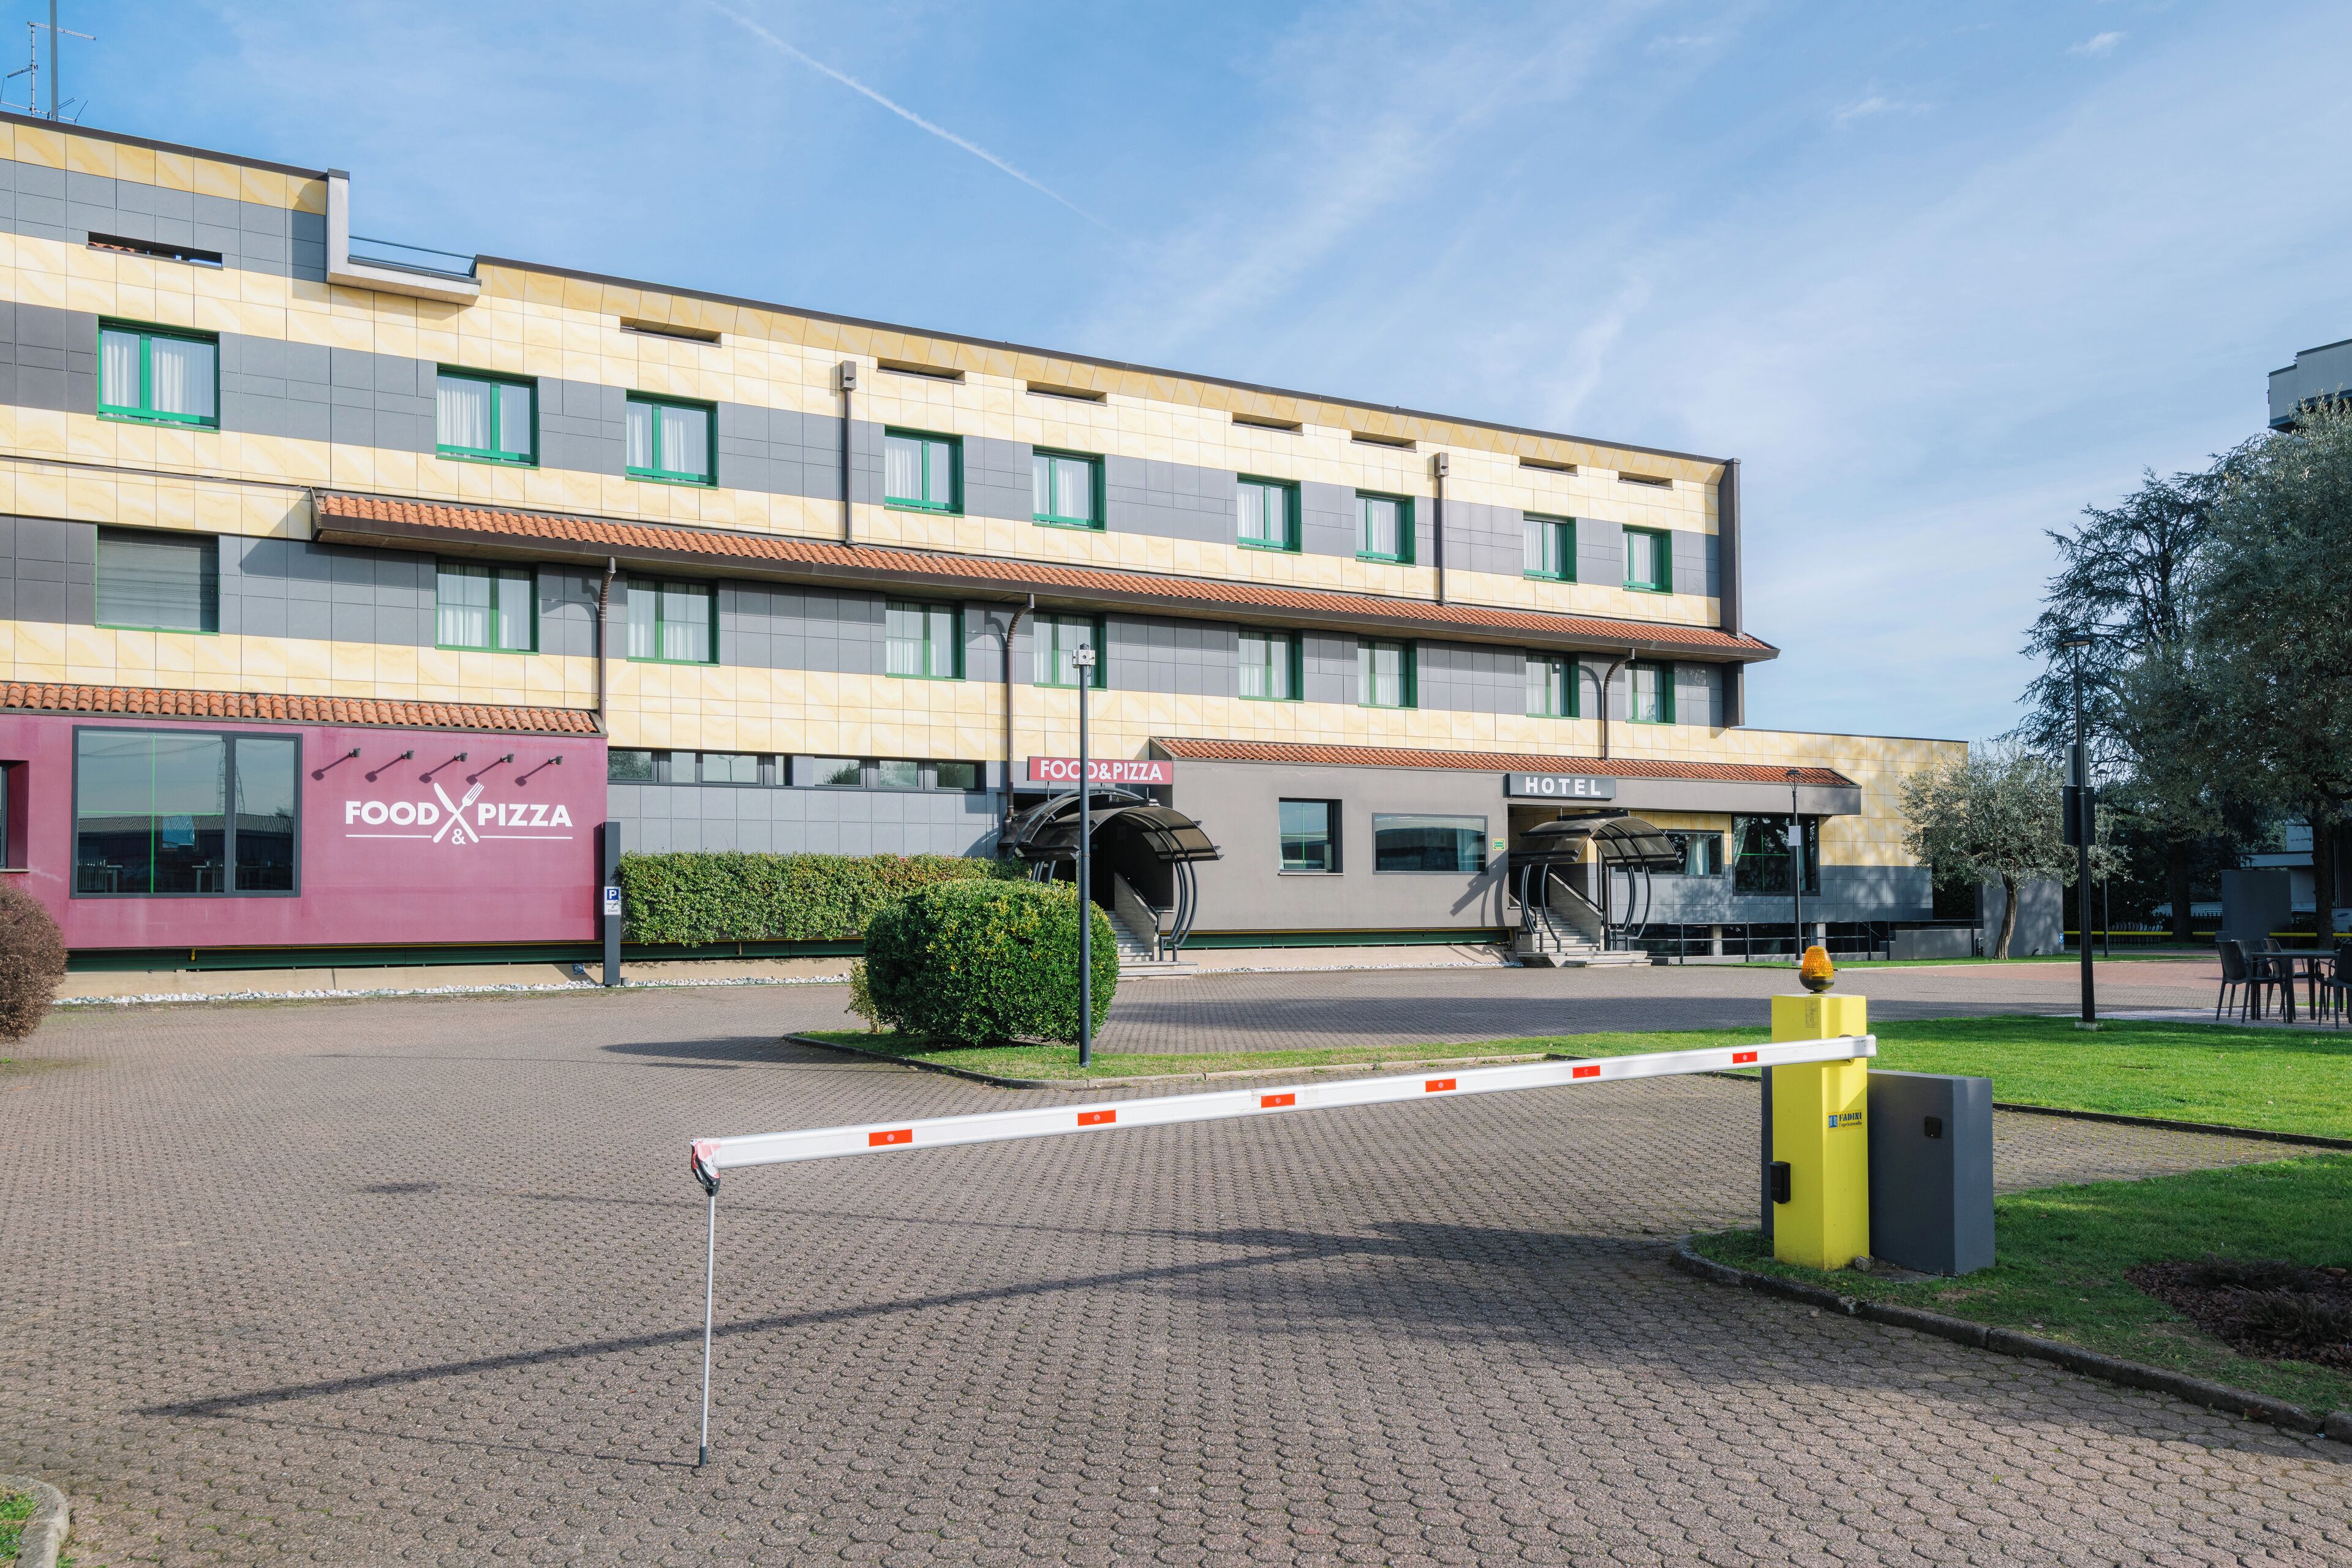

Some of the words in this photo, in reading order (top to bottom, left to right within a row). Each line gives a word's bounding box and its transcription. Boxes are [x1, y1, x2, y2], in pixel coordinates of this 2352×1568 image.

[1041, 760, 1163, 781] FOOD&PIZZA
[1525, 777, 1601, 796] HOTEL
[345, 801, 440, 825] FOOD
[451, 828, 467, 845] &
[478, 803, 573, 827] PIZZA
[609, 890, 617, 899] P
[1839, 1112, 1861, 1121] FADINI
